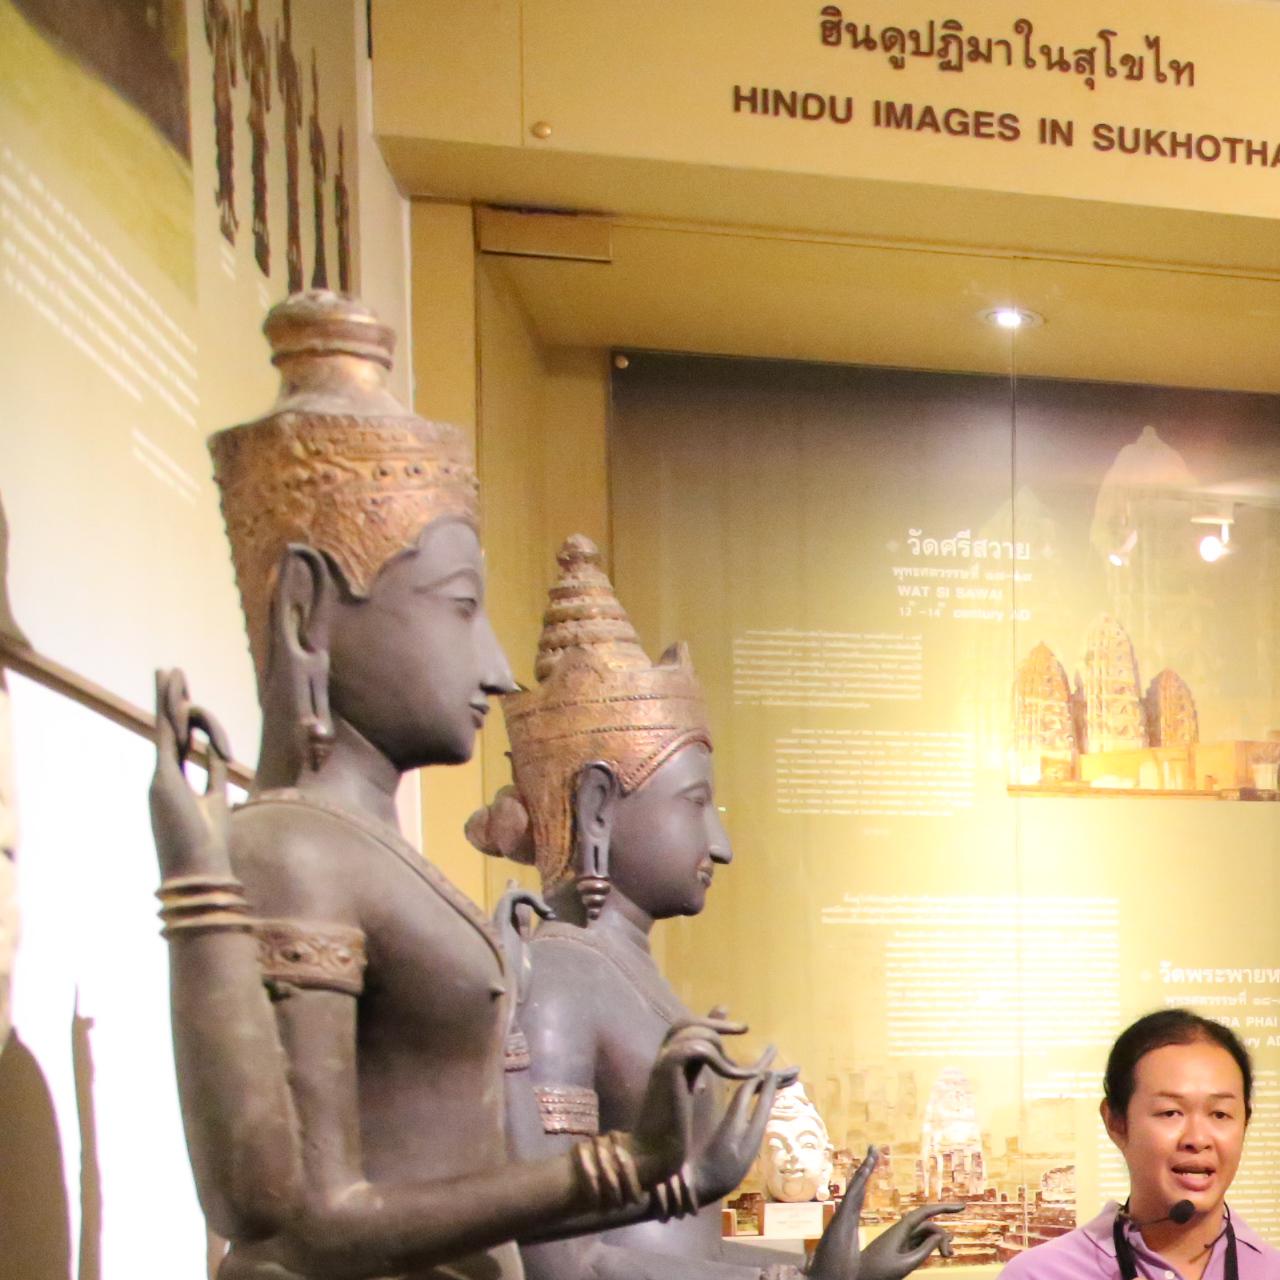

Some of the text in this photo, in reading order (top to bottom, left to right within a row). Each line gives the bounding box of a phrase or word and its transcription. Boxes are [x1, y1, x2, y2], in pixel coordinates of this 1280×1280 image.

[819, 5, 1195, 90] ฮินดูปฏิมาในสุโขไท
[732, 84, 853, 125] HINDU
[873, 99, 1021, 143] IMAGES
[1039, 117, 1074, 147] IN
[907, 528, 1030, 560] วัดศรีสวาย
[896, 586, 1003, 600] WAT SI SAWAI
[1246, 1016, 1278, 1027] PHAI
